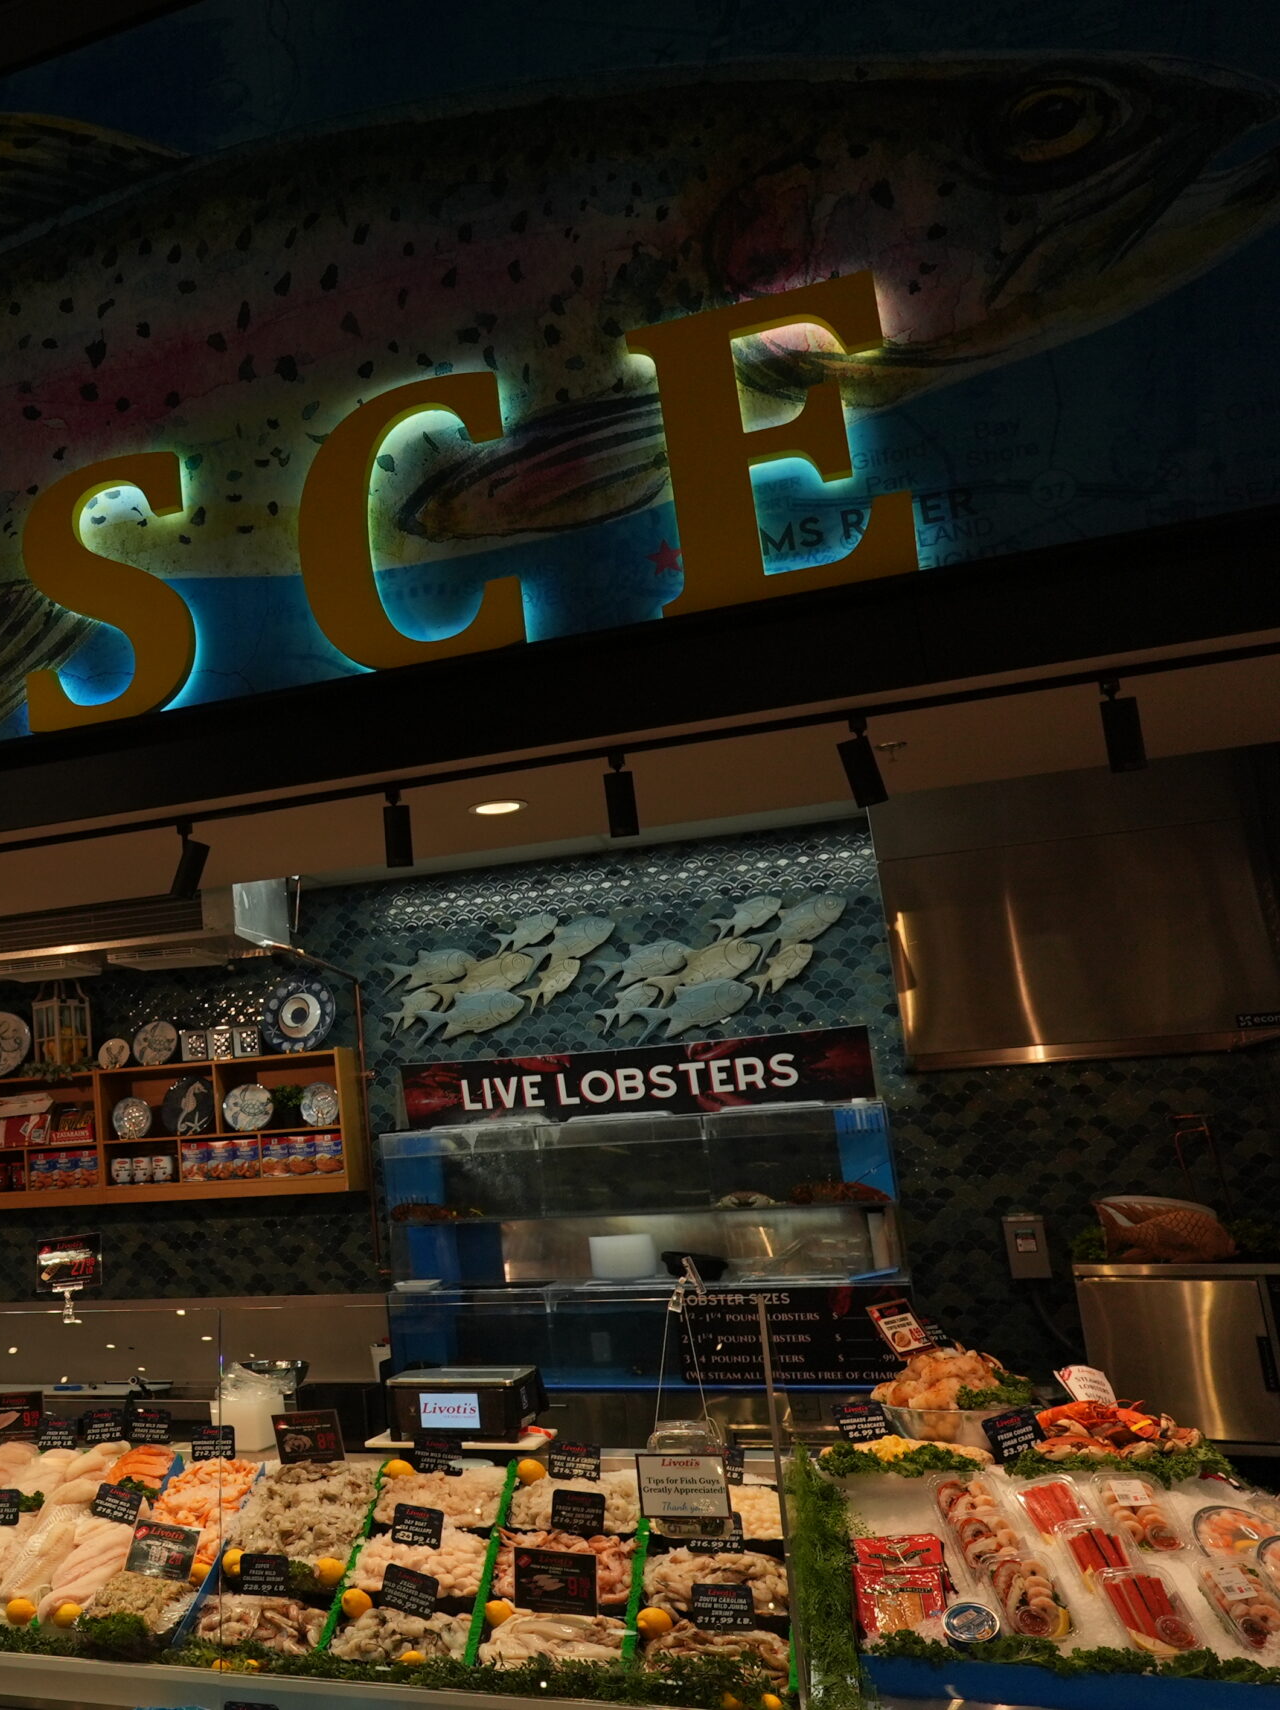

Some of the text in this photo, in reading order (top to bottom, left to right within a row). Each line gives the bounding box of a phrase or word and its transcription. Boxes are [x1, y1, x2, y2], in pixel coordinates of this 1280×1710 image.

[760, 516, 824, 557] MS
[460, 1052, 800, 1111] LIVE LOBSTERS
[749, 1292, 791, 1305] SZES
[725, 1312, 761, 1322] POUN
[767, 1312, 820, 1321] LOBSTERS
[717, 1334, 757, 1344] POUND
[758, 1334, 812, 1343] LBSTERS
[711, 1354, 751, 1364] POUND
[753, 1354, 806, 1363] LOTERS
[708, 1371, 741, 1380] STEAM
[743, 1371, 761, 1380] ALL
[817, 1371, 844, 1380] FREE
[846, 1371, 860, 1380] OF
[422, 1402, 477, 1415] Livoti's
[661, 1458, 700, 1468] Livoti's
[647, 1476, 720, 1487] Tips for Fish Guys
[642, 1485, 726, 1496] Greatly Appreciated!
[662, 1501, 688, 1512] Thank
[150, 1526, 186, 1540] Livoti's
[689, 1540, 741, 1549] $16.99 LB.
[698, 1595, 718, 1603] SOUTH
[696, 1615, 753, 1625] $11.99 LB.
